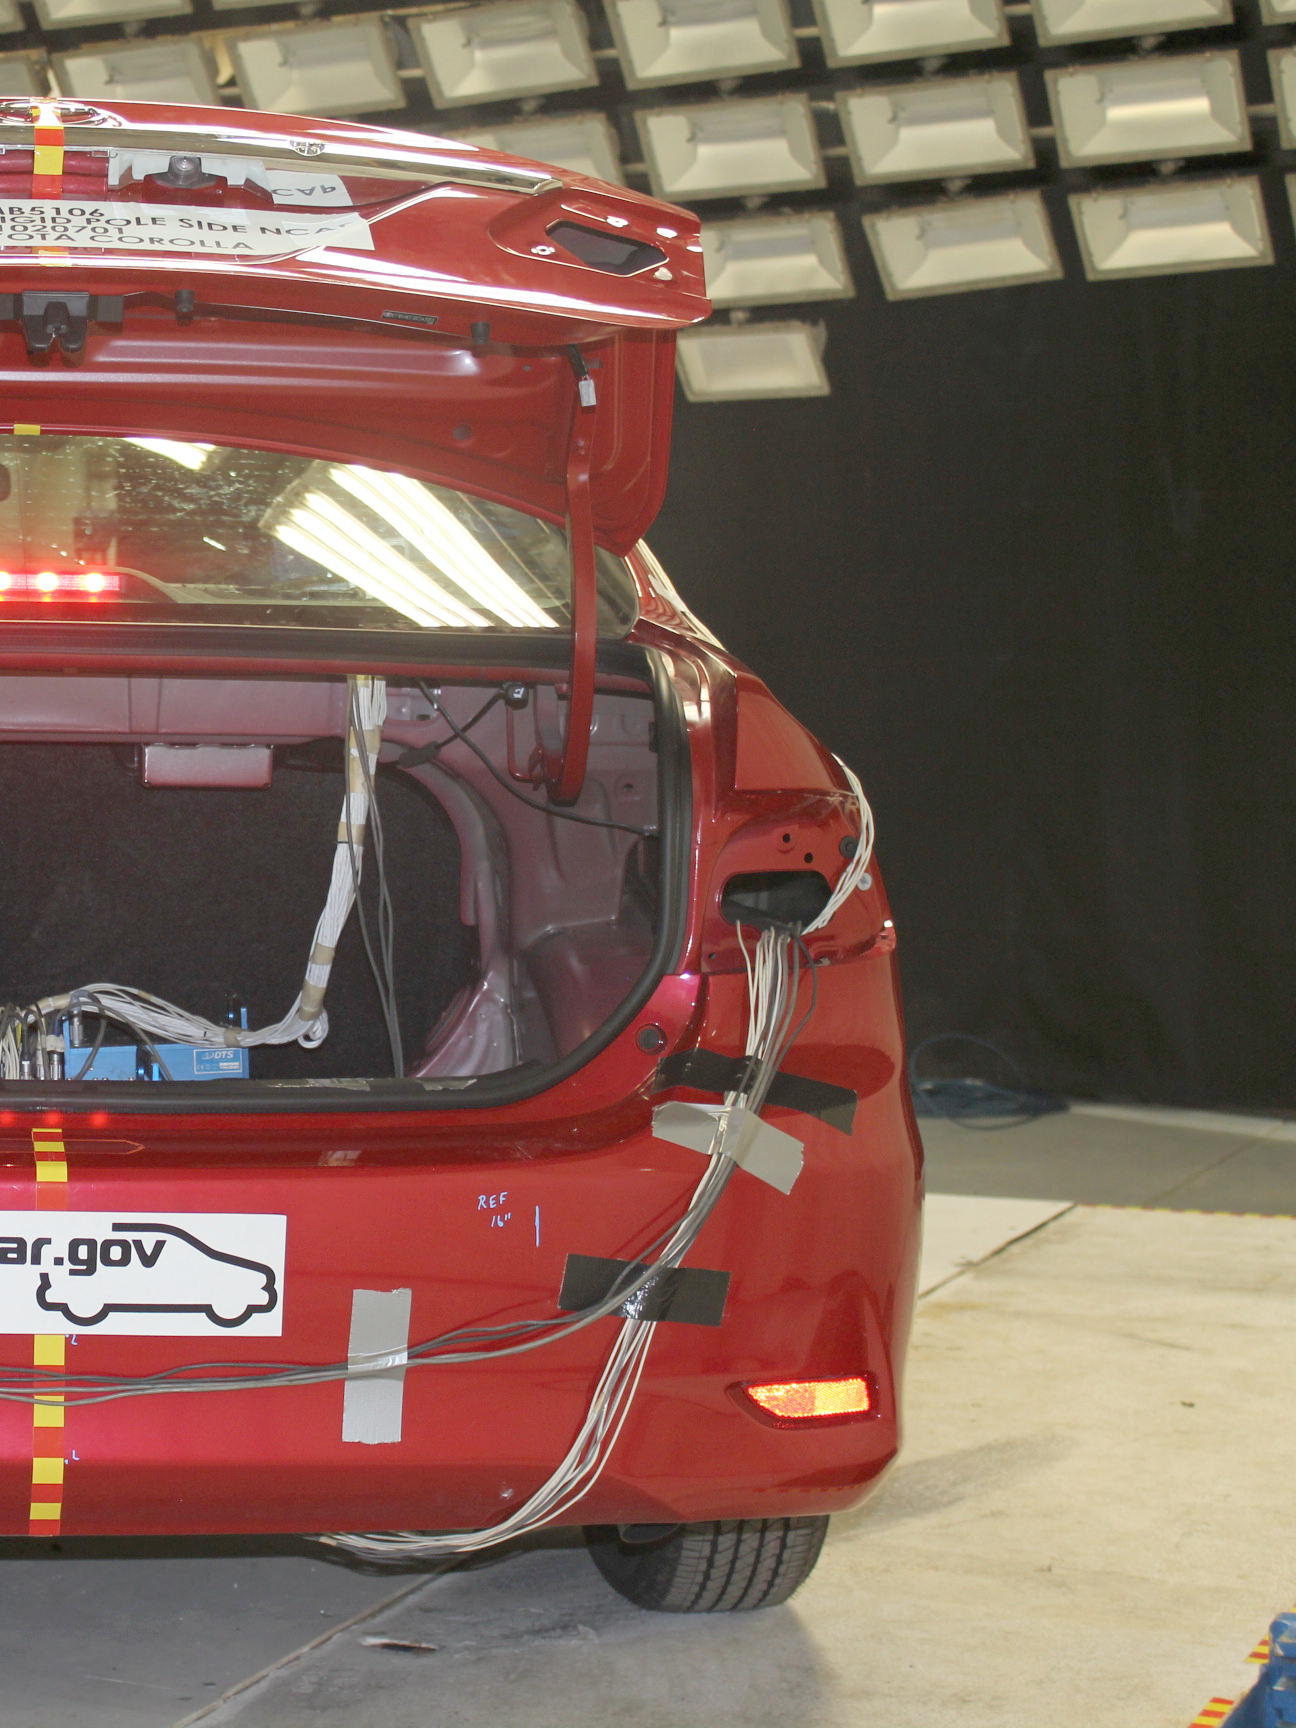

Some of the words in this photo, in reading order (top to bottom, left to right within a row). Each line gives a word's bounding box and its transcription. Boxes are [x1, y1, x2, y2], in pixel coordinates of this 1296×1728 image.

[85, 216, 167, 227] POLE
[178, 218, 248, 235] SIDE
[89, 235, 255, 251] COROLLA
[214, 1050, 234, 1060] DTS
[477, 1191, 509, 1211] REF
